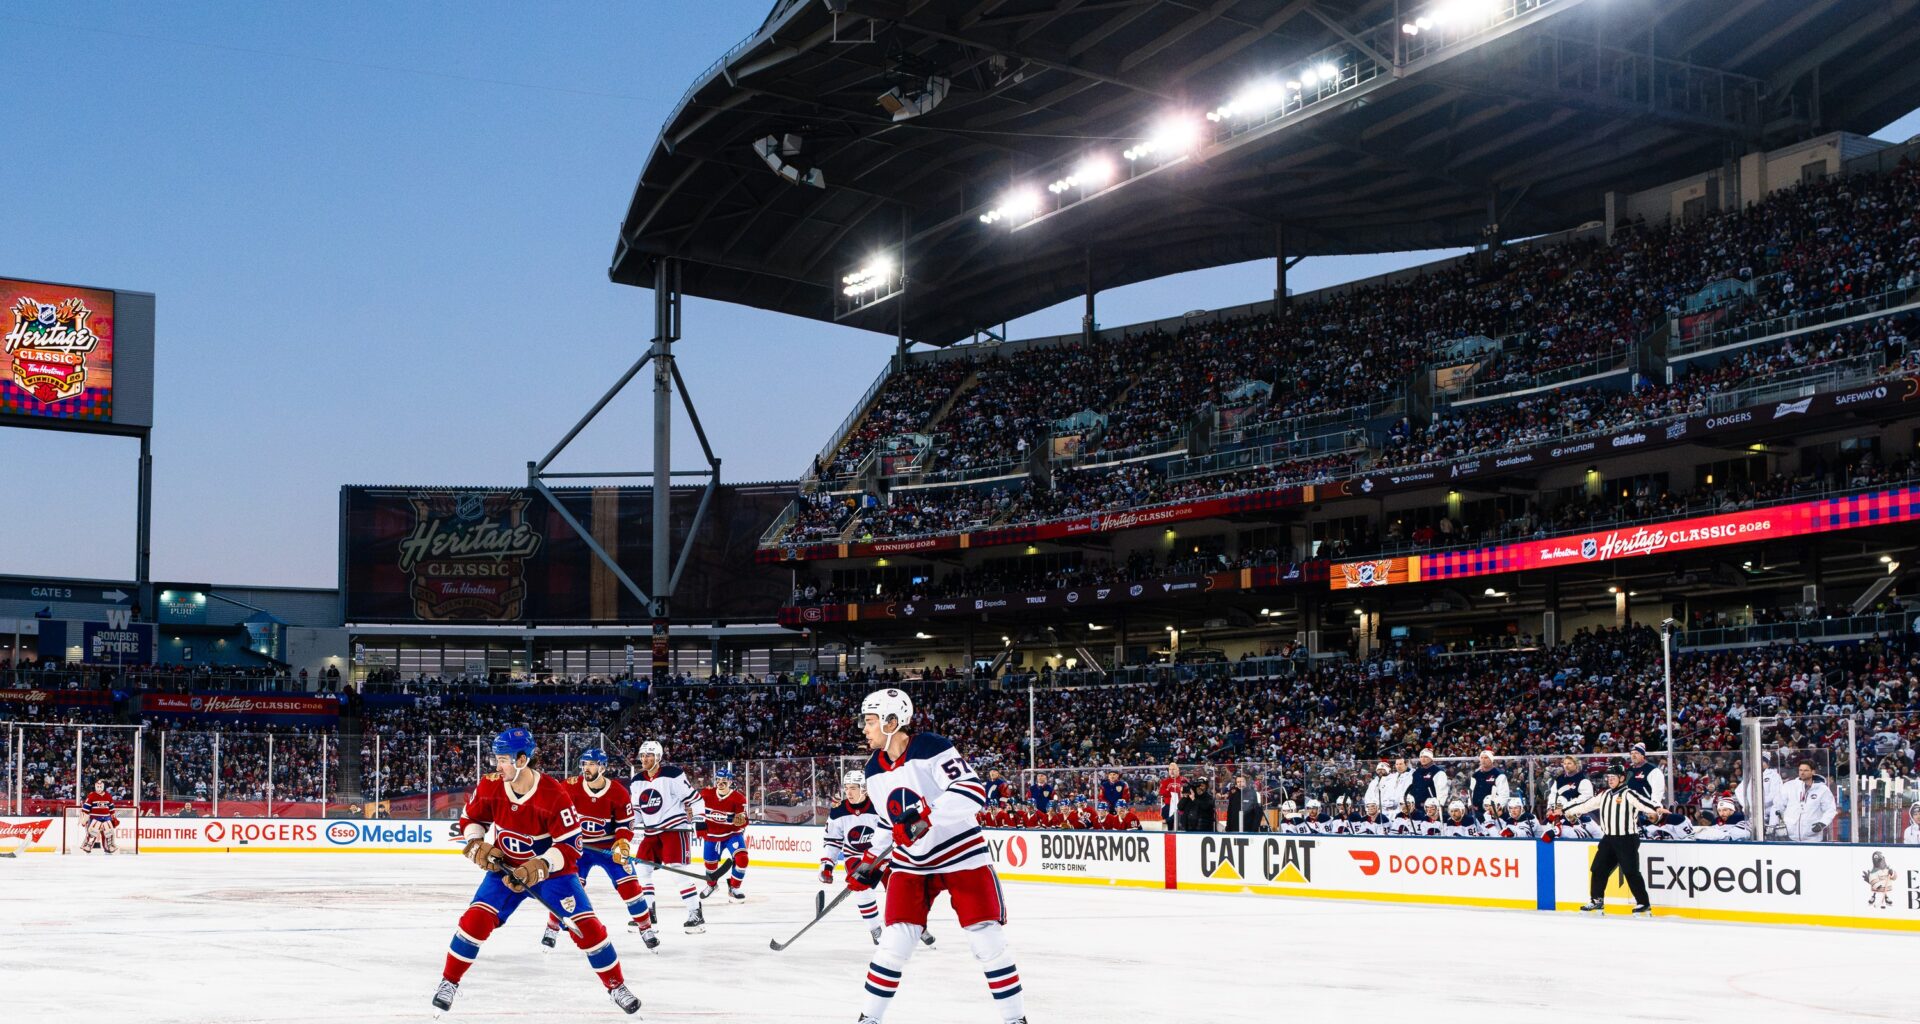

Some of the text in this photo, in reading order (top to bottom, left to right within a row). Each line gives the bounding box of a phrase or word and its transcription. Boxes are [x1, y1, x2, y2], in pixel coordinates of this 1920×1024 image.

[5, 321, 95, 354] Heritage
[20, 350, 74, 364] CLASSIC
[1836, 389, 1875, 405] SAFEWAY
[1716, 412, 1752, 426] ROGERS
[1612, 433, 1646, 447] Gillette
[1564, 443, 1595, 455] HYUNDAI
[1496, 454, 1534, 468] Scotiabank
[1401, 473, 1434, 483] DOORDASH
[1138, 510, 1175, 522] CLASSIC
[402, 518, 539, 568] Heritage
[875, 540, 936, 551] WINNIPEG 2026
[1540, 549, 1553, 560] Tim
[1554, 547, 1579, 559] Hortons
[1600, 527, 1669, 561] Heritage
[1669, 524, 1736, 543] CLASSIC
[1739, 520, 1770, 533] 2026
[428, 563, 510, 577] CLASSIC
[31, 587, 72, 598] GATE 3
[441, 582, 458, 595] Tim
[459, 582, 496, 595] Hortons
[984, 600, 1006, 608] Expedia
[1026, 596, 1047, 604] TRULY
[98, 630, 139, 642] BOMBER
[101, 641, 139, 653] STORE
[204, 696, 254, 713] Heritage
[255, 701, 301, 710] CLASSIC
[941, 758, 972, 780] 57
[174, 828, 198, 840] TIRE
[231, 824, 317, 841] ROGERS
[331, 827, 355, 838] Esso
[362, 824, 433, 843] Medals
[750, 836, 812, 853] AutoTrader.ca
[1040, 834, 1151, 863] BODYARMOR
[1201, 836, 1315, 883] CAT CAT
[1390, 855, 1519, 878] DOORDASH
[1042, 862, 1086, 872] SPORTS DRINK
[1647, 856, 1801, 898] Expedia
